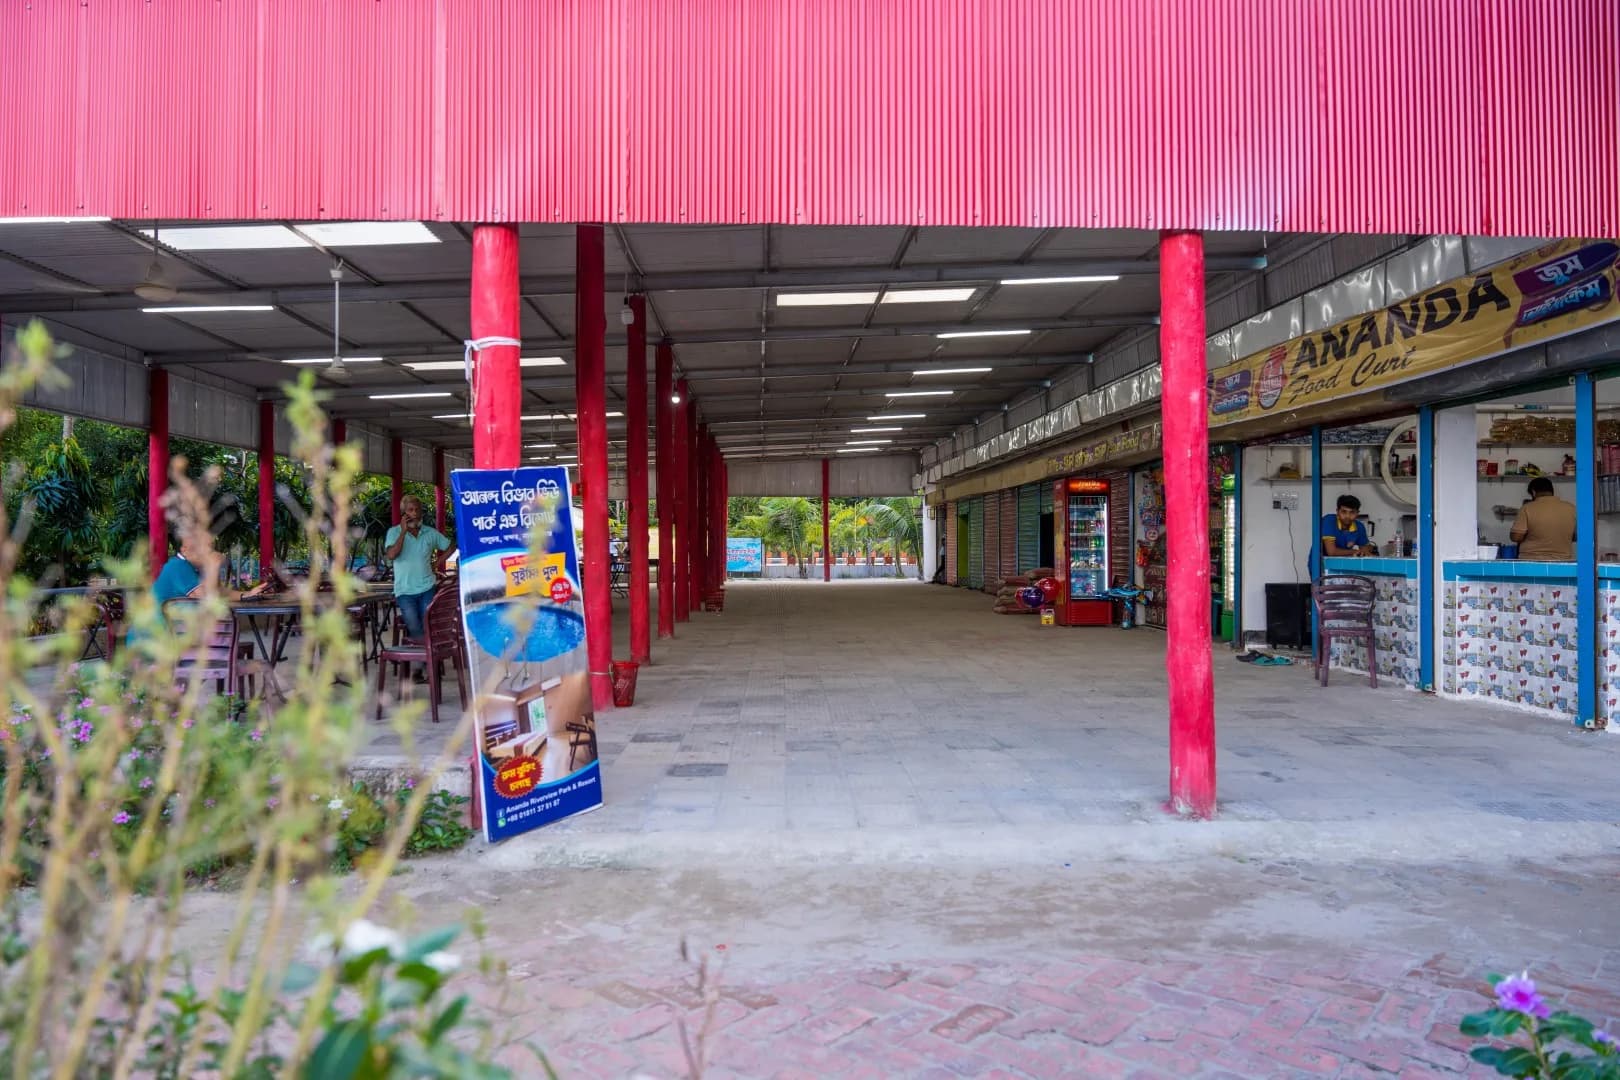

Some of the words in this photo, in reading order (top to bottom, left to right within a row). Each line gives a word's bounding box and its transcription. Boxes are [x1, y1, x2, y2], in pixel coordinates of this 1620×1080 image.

[1290, 272, 1512, 375] ANANDA
[1286, 367, 1341, 405] Food
[1350, 346, 1418, 388] Curt
[460, 490, 500, 506] আনন্দ
[501, 481, 536, 505] রিভার
[472, 510, 497, 531] পার্ক
[506, 800, 530, 814] Ananda
[530, 790, 558, 806] Riverview
[558, 785, 572, 796] Park
[577, 776, 596, 788] Resort
